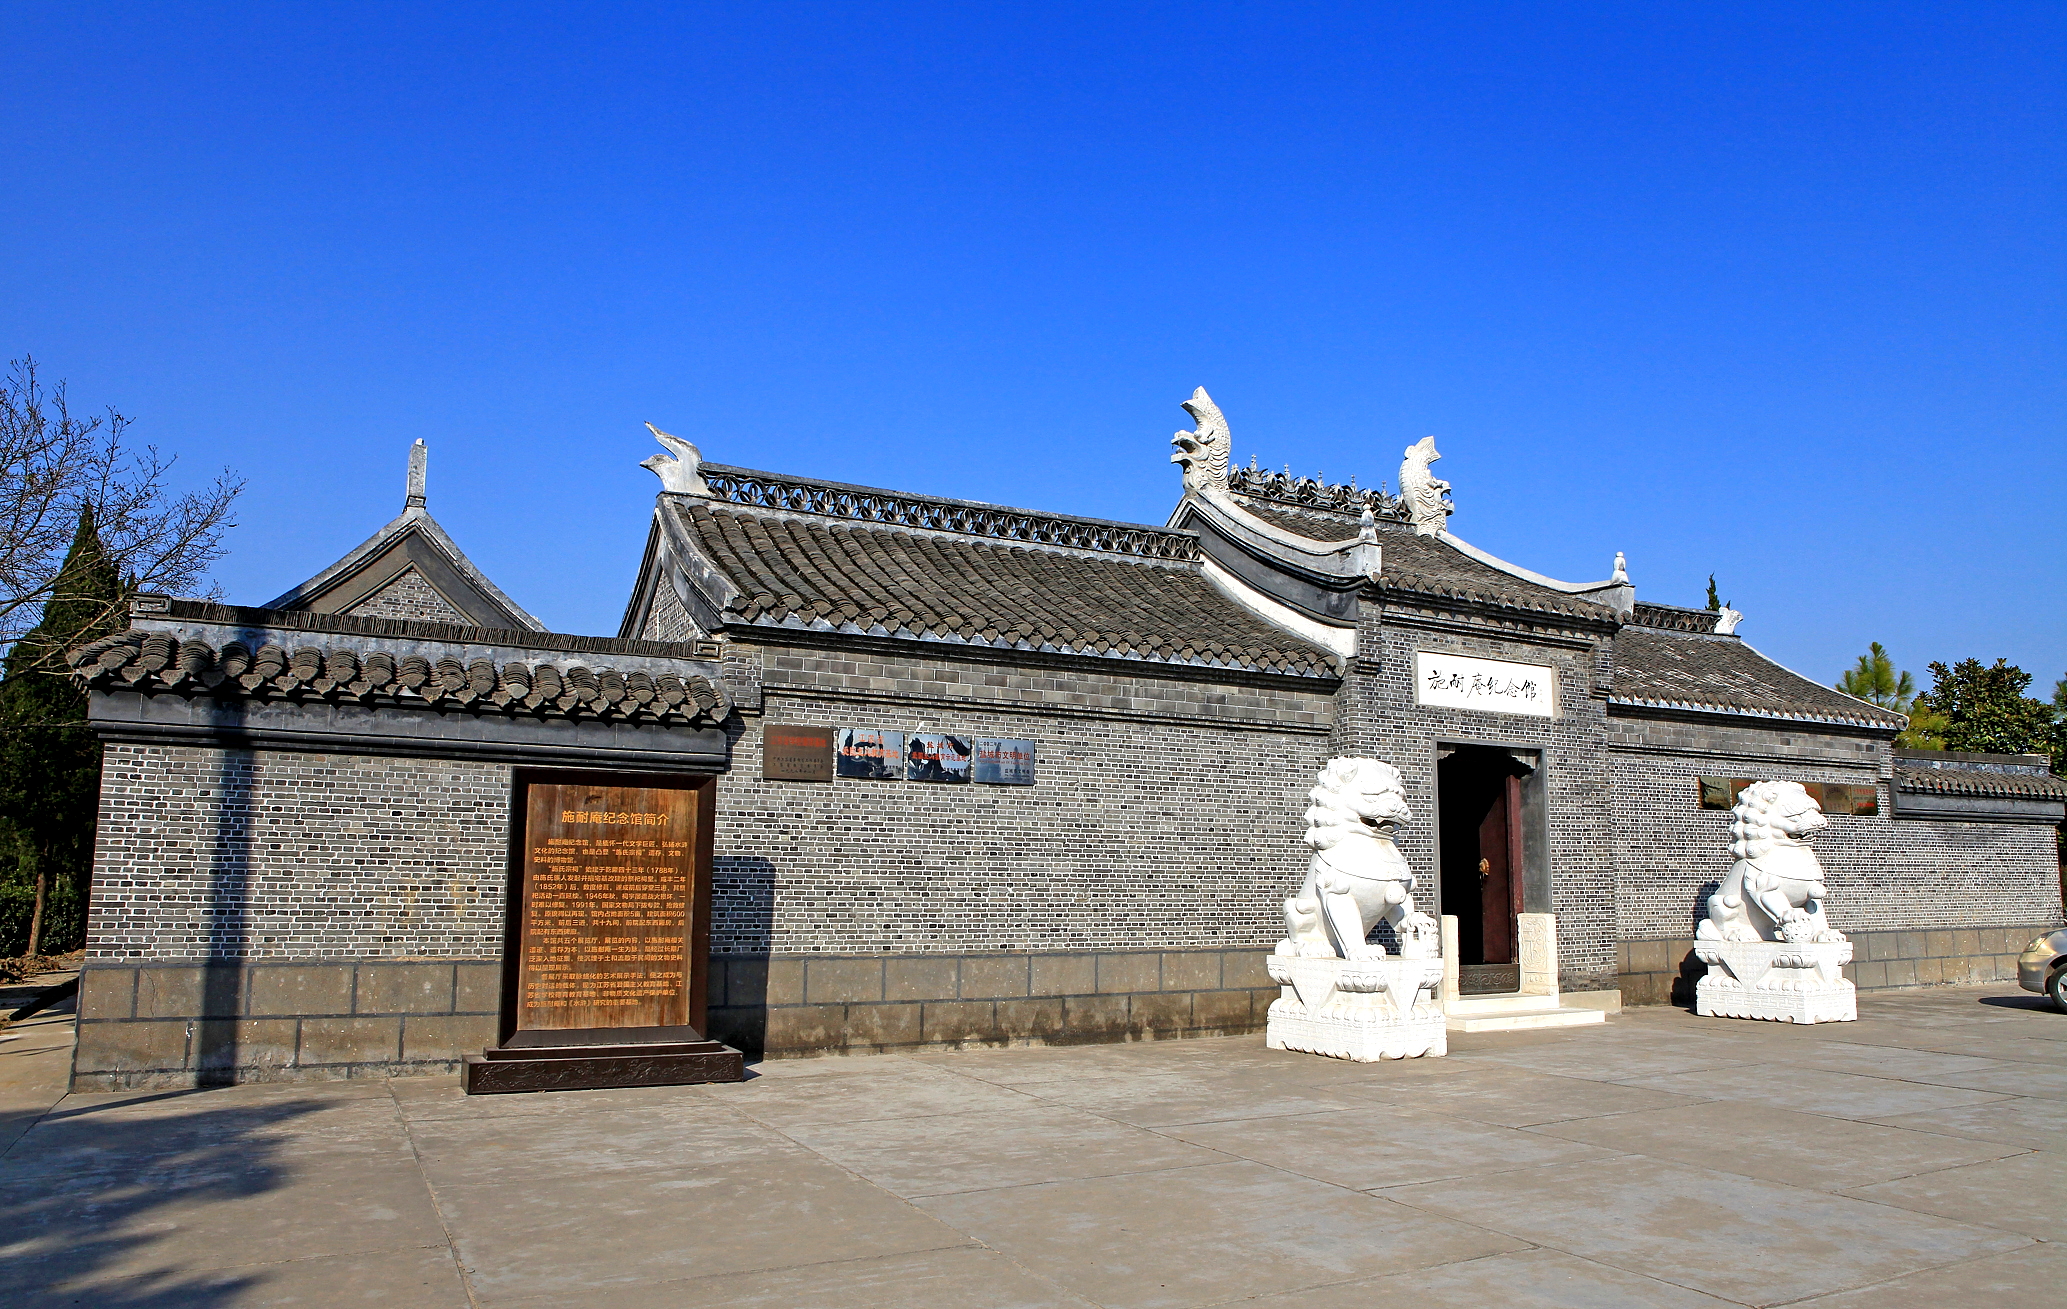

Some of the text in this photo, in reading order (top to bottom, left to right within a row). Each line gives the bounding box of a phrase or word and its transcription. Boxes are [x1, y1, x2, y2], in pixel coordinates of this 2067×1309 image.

[1427, 669, 1537, 702] 施耐庵纪念馆
[858, 733, 885, 745] 江苏省
[840, 745, 899, 759] 爱国主义教育基地
[979, 750, 1031, 761] 盐城市文明单位
[561, 810, 669, 826] 施耐庵纪念馆简介
